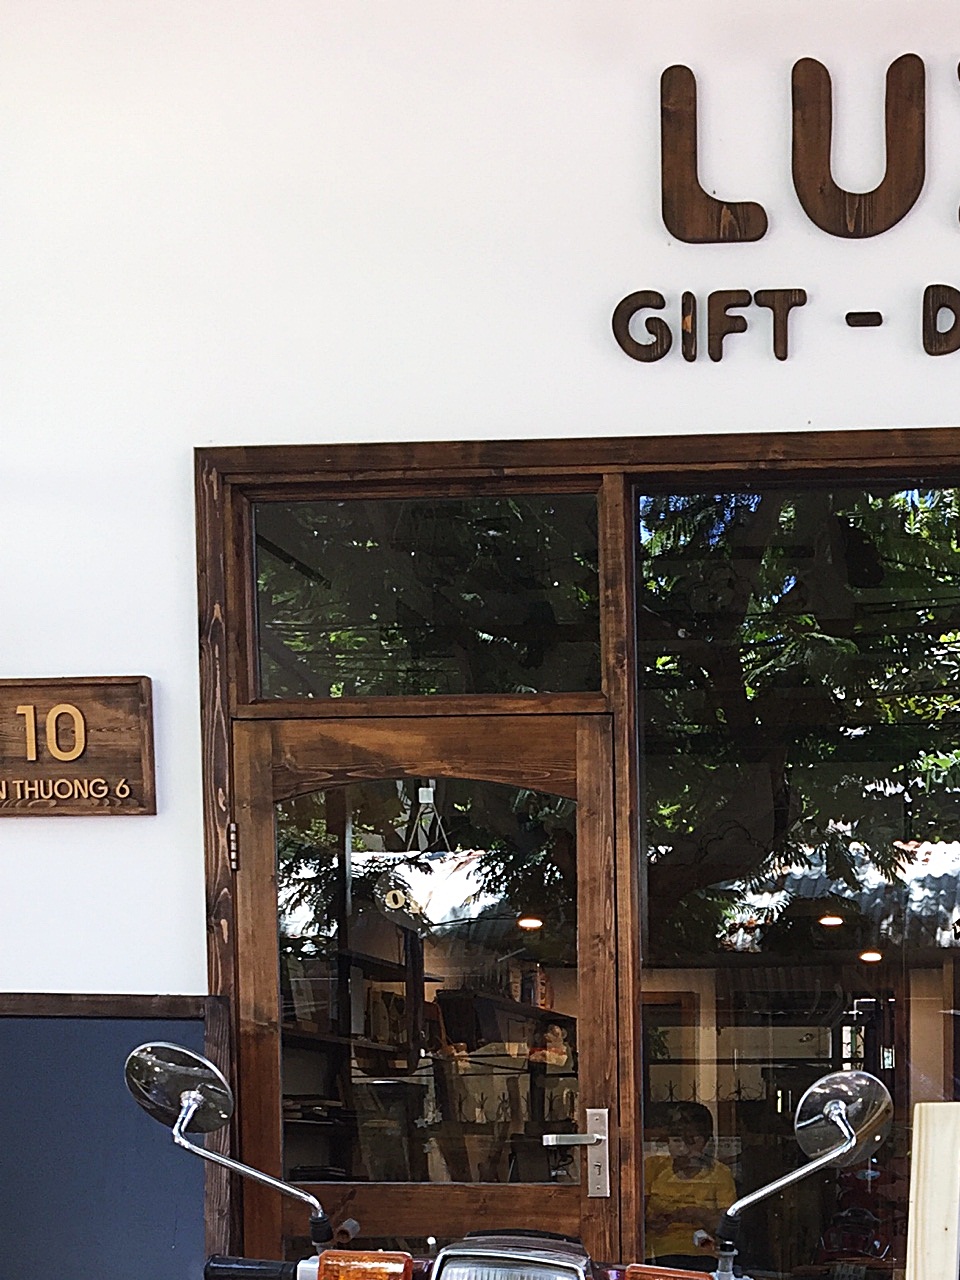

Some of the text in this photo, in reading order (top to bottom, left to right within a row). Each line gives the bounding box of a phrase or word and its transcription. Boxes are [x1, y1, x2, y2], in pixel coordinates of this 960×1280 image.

[611, 289, 807, 363] GIFT
[16, 703, 86, 762] 10
[12, 778, 109, 799] THUONG
[115, 777, 131, 799] 6
